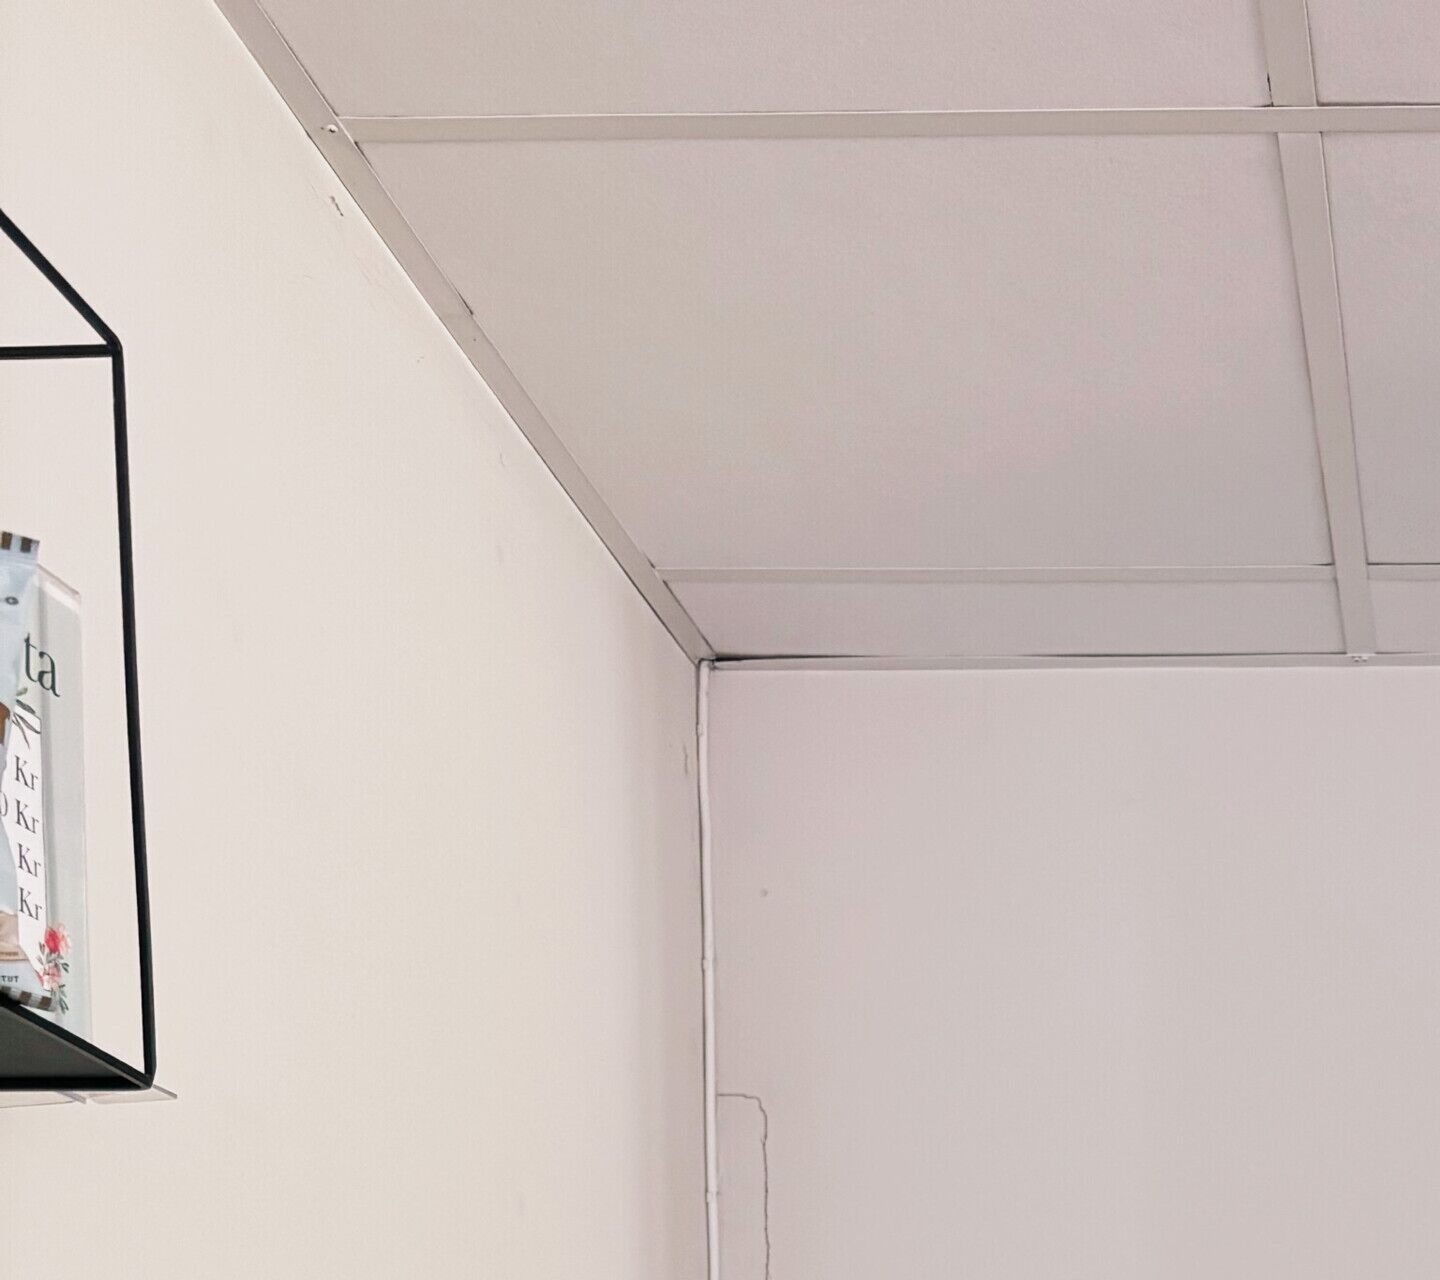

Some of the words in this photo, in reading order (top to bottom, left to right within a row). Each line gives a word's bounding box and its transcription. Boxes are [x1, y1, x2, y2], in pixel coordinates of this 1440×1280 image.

[15, 755, 38, 790] Kr
[15, 799, 39, 834] Kr
[17, 842, 41, 877] Kr
[19, 887, 42, 921] Kr
